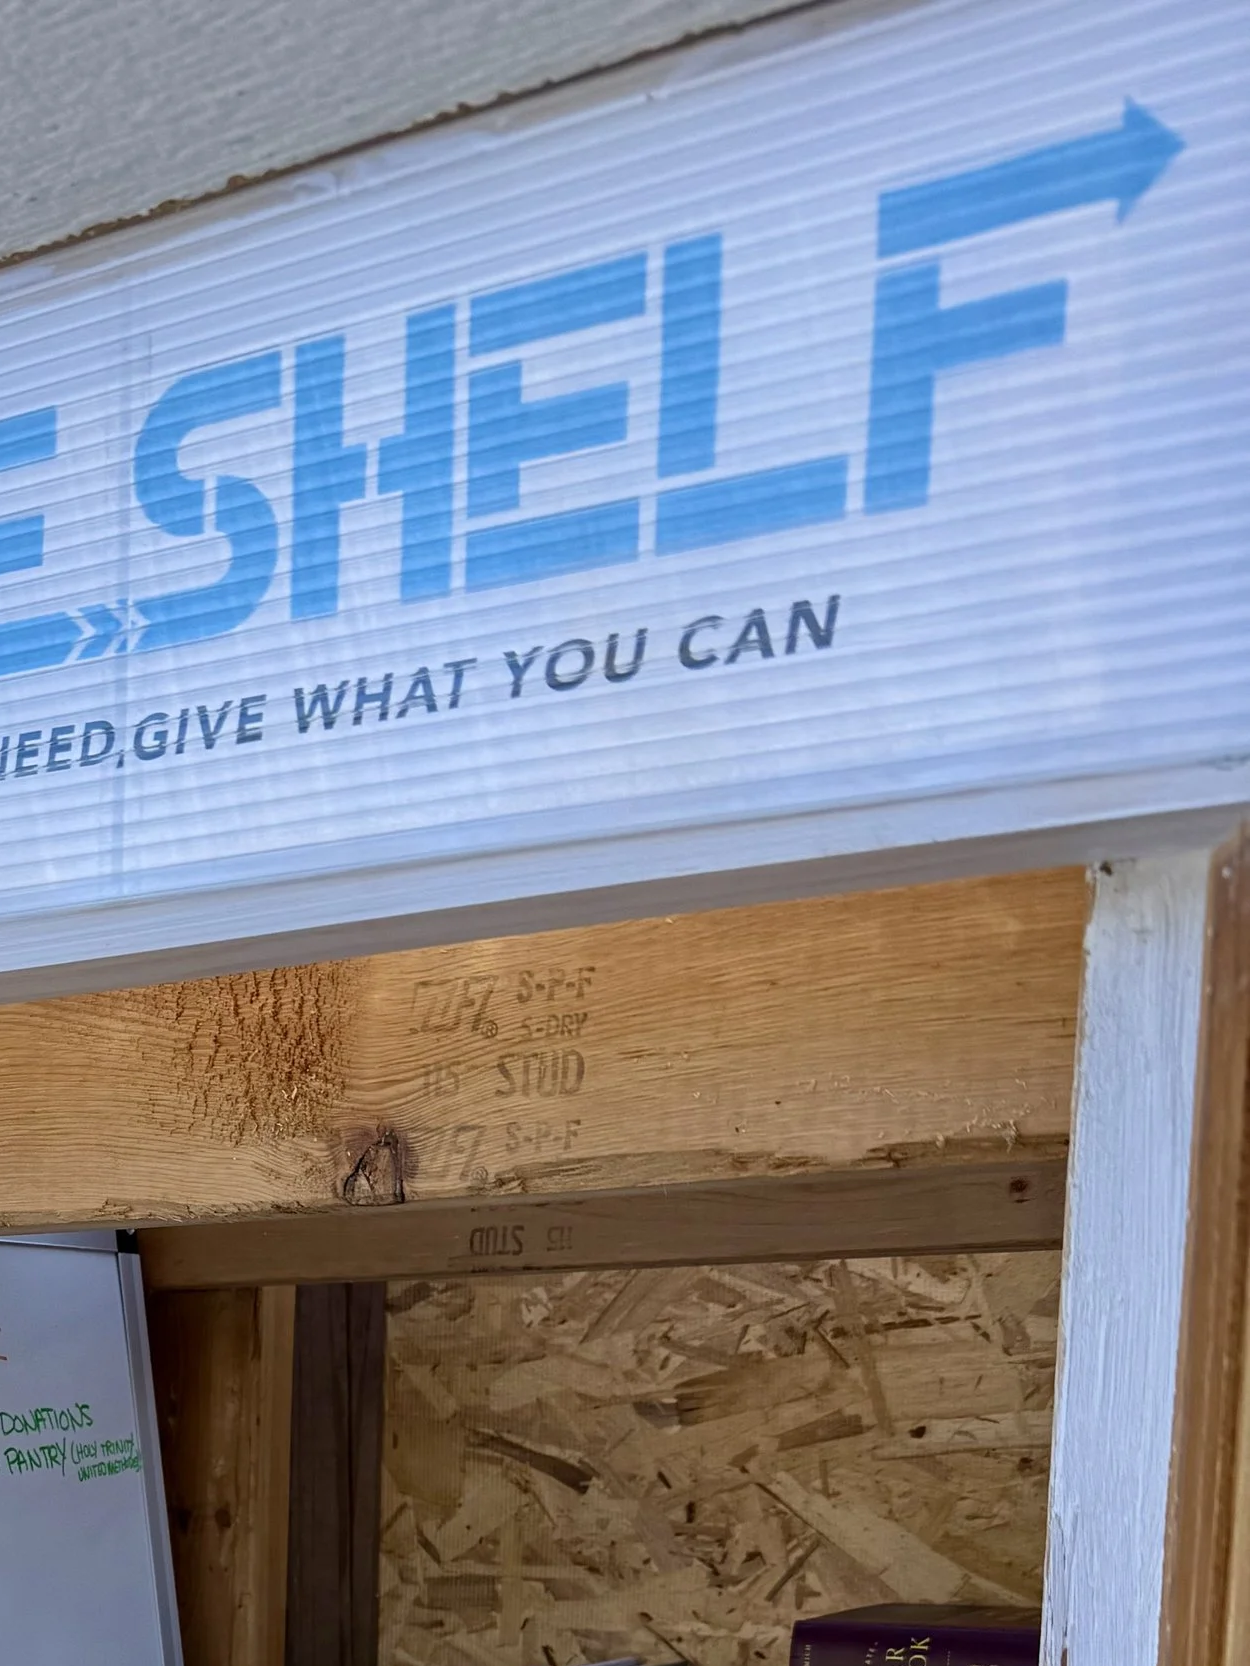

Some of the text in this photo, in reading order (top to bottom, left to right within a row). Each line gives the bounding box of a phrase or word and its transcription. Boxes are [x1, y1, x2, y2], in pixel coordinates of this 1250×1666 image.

[130, 96, 1185, 652] SHELF
[132, 694, 268, 762] GIVE
[293, 657, 477, 734] WHAT
[503, 627, 649, 699] YOU
[678, 594, 841, 671] CAN
[495, 1049, 586, 1099] STUD
[469, 1225, 525, 1256] STUD
[4, 1437, 67, 1477] PANTRY
